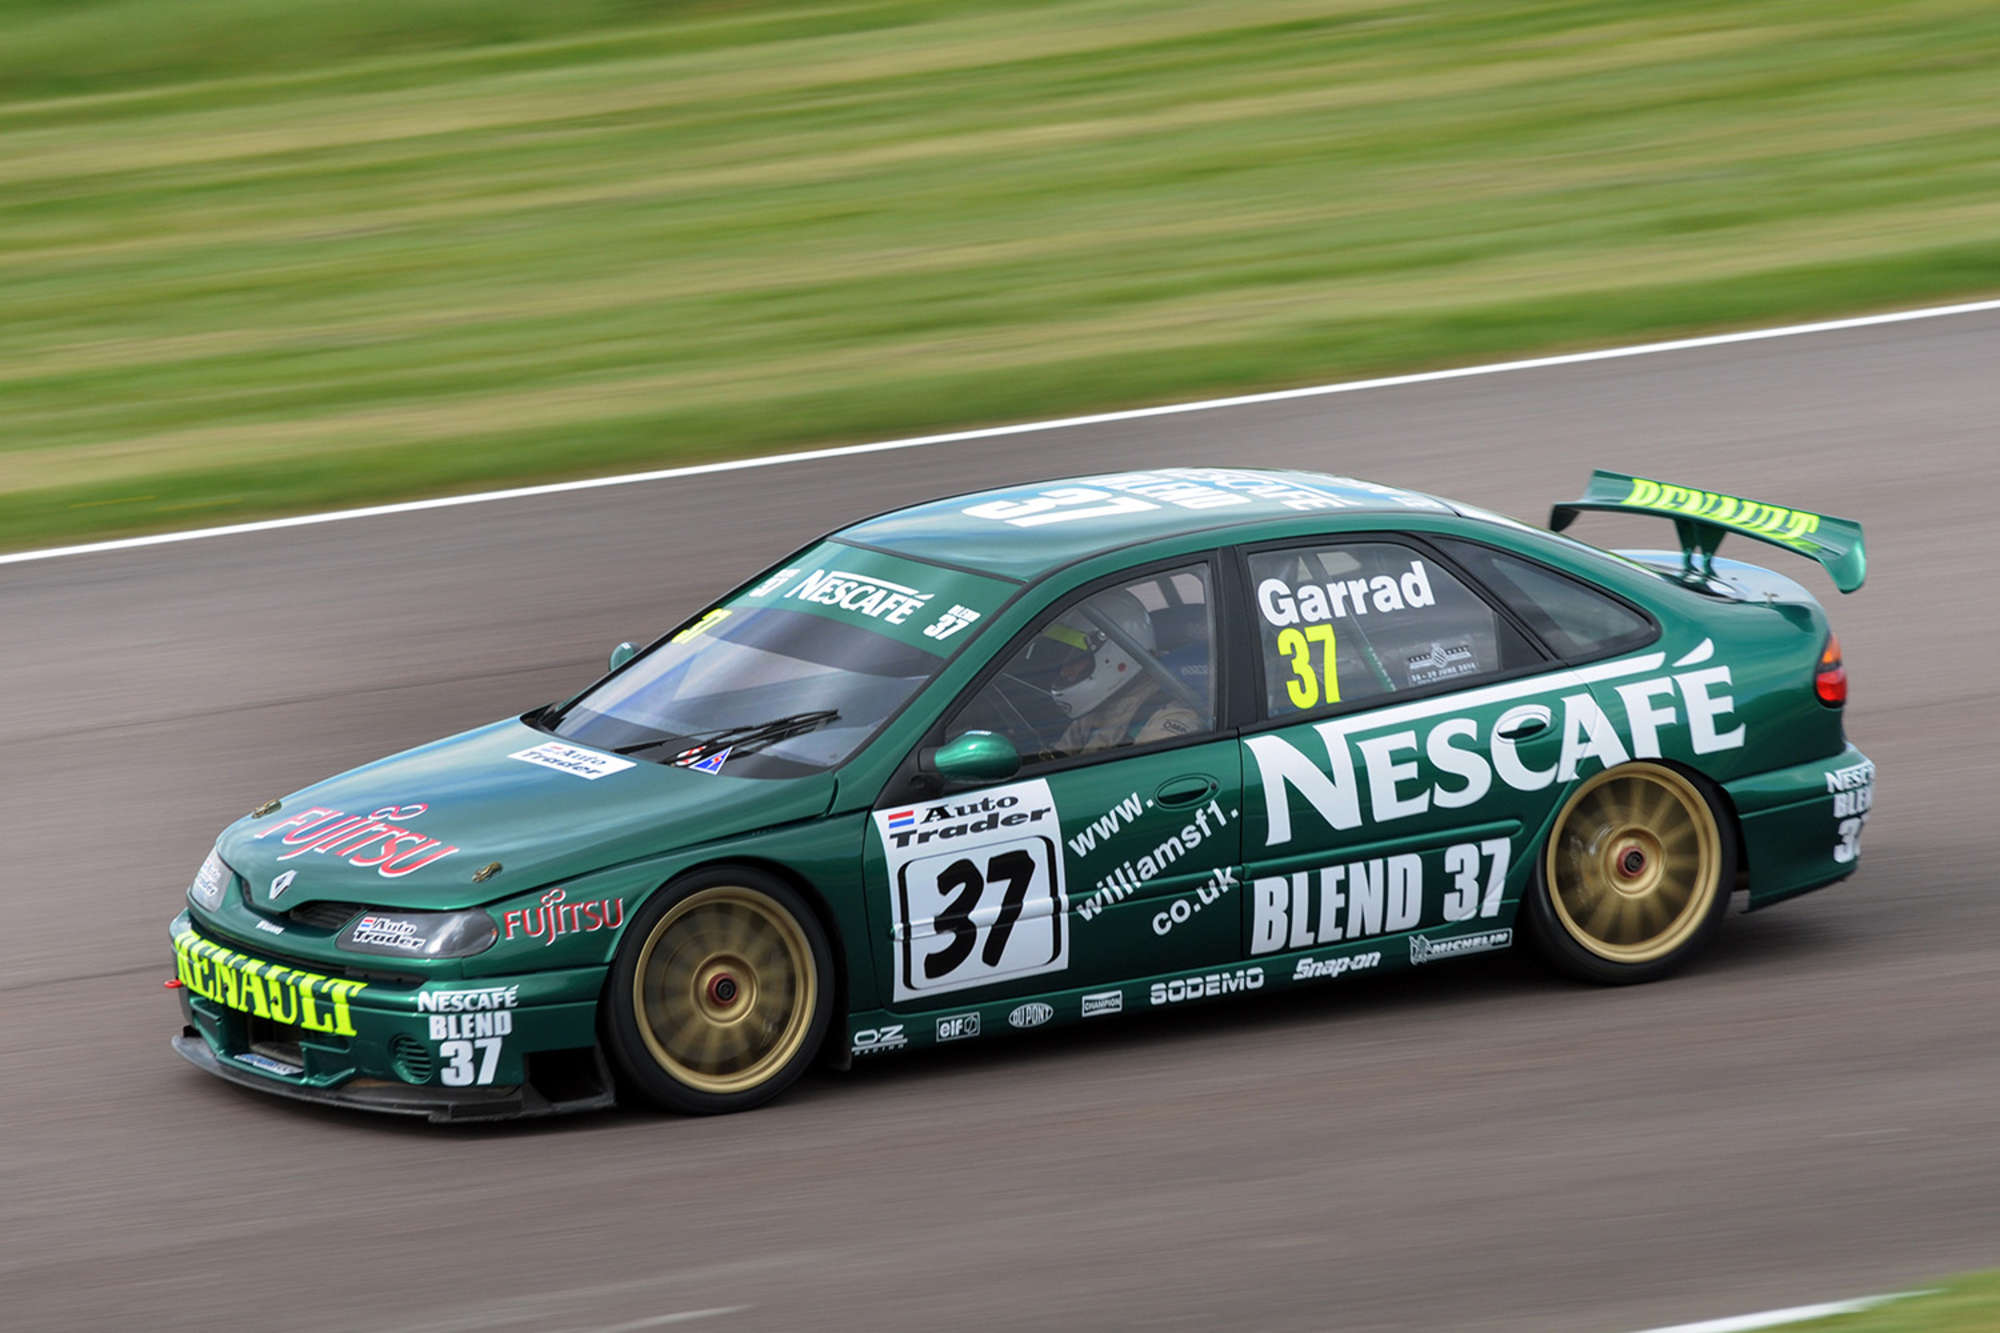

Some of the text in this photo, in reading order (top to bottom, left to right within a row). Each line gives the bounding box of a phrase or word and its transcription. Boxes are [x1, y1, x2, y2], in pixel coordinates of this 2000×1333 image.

[961, 488, 1163, 529] 37
[784, 569, 935, 625] NESCAFÉ
[1257, 560, 1436, 626] Garrad
[923, 614, 969, 640] 37
[1276, 623, 1341, 709] 37
[1243, 637, 1747, 848] NESCAFÉ
[889, 806, 1051, 849] Trader
[922, 794, 1020, 825] Auto
[1068, 791, 1154, 858] www.
[254, 803, 460, 878] FUJITSU
[1075, 799, 1239, 922] williamsf1.
[504, 889, 624, 947] FUJITSU
[924, 849, 1035, 980] 37
[1151, 865, 1241, 936] co.uk
[1251, 836, 1512, 957] BLEND 37
[353, 929, 426, 951] Trader
[374, 917, 417, 935] Auto
[1432, 932, 1508, 954] MICHELIN
[174, 928, 368, 1037] RENAULT
[1150, 967, 1264, 1005] SODEMO
[1293, 951, 1381, 980] Snap-on
[418, 984, 520, 1013] NESCAFÉ
[429, 1010, 512, 1040] BLEND
[939, 1019, 964, 1039] elf
[440, 1036, 503, 1088] 37
